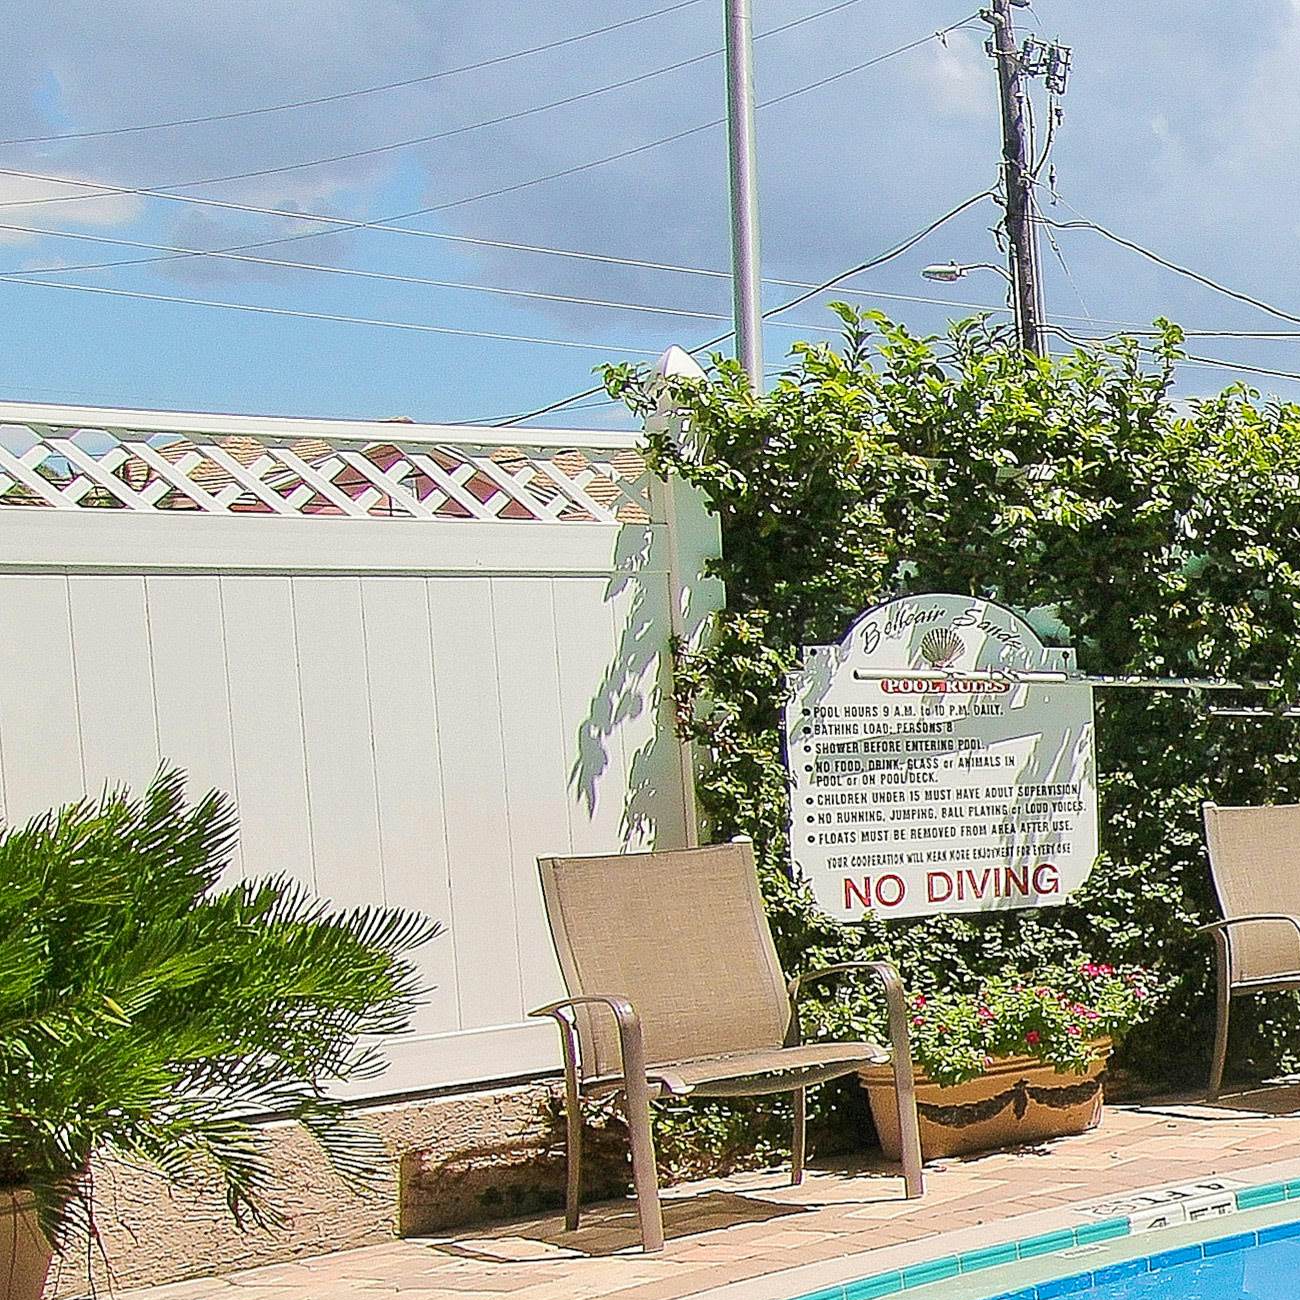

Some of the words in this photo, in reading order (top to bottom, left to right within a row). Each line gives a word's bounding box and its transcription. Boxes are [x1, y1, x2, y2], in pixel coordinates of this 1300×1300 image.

[889, 681, 941, 692] POOL
[946, 681, 1005, 692] RULES
[814, 706, 840, 718] POOL
[844, 706, 878, 717] HOURS
[883, 706, 889, 716] 9
[894, 706, 916, 717] A.M.
[921, 705, 930, 716] to
[935, 705, 944, 716] 10
[974, 704, 1003, 715] DAILY.
[814, 724, 859, 735] BATHING
[897, 722, 943, 734] PERSONS
[947, 722, 952, 732] 8
[816, 742, 859, 754] SHOWER
[864, 741, 900, 752] BEFORE
[905, 740, 954, 751] ENTERING
[958, 739, 985, 750] POOL.
[816, 761, 830, 772] NO
[835, 760, 864, 772] FOOD,
[907, 758, 939, 769] GLASS
[944, 760, 953, 768] or
[958, 756, 1000, 767] ANIMALS
[1005, 756, 1015, 766] IN
[817, 775, 842, 786] POOL
[847, 777, 857, 785] or
[863, 774, 875, 785] ON
[881, 773, 905, 784] POOL
[910, 772, 938, 783] DECK.
[817, 793, 868, 805] CHILDREN
[872, 791, 905, 803] UNDER
[910, 790, 920, 801] 15
[925, 789, 951, 800] MUST
[956, 788, 980, 799] HAVE
[985, 786, 1013, 798] ADULT
[818, 812, 831, 824] NO
[837, 810, 885, 823] RUNNING,
[890, 808, 937, 820] JUMPING,
[942, 807, 964, 818] BALL
[969, 805, 1008, 816] PLAYING
[1011, 806, 1021, 815] or
[1026, 802, 1048, 814] LOUD
[1052, 801, 1086, 813] VOICES.
[819, 831, 856, 844] FLOATS
[861, 830, 889, 842] MUST
[894, 829, 905, 840] BE
[911, 826, 956, 839] REMOVED
[961, 825, 987, 836] FROM
[992, 823, 1016, 835] AREA
[1020, 821, 1049, 833] AFTER
[1052, 820, 1072, 831] USE.
[827, 857, 848, 869] YOUR
[851, 853, 904, 867] COOPERATION
[907, 852, 924, 864] WILL
[927, 850, 947, 862] MEAN
[950, 849, 970, 860] MORE
[973, 846, 1014, 859] ENJOYMENT
[1017, 845, 1030, 857] FOR
[843, 874, 906, 910] NO
[927, 863, 1059, 902] DIVING
